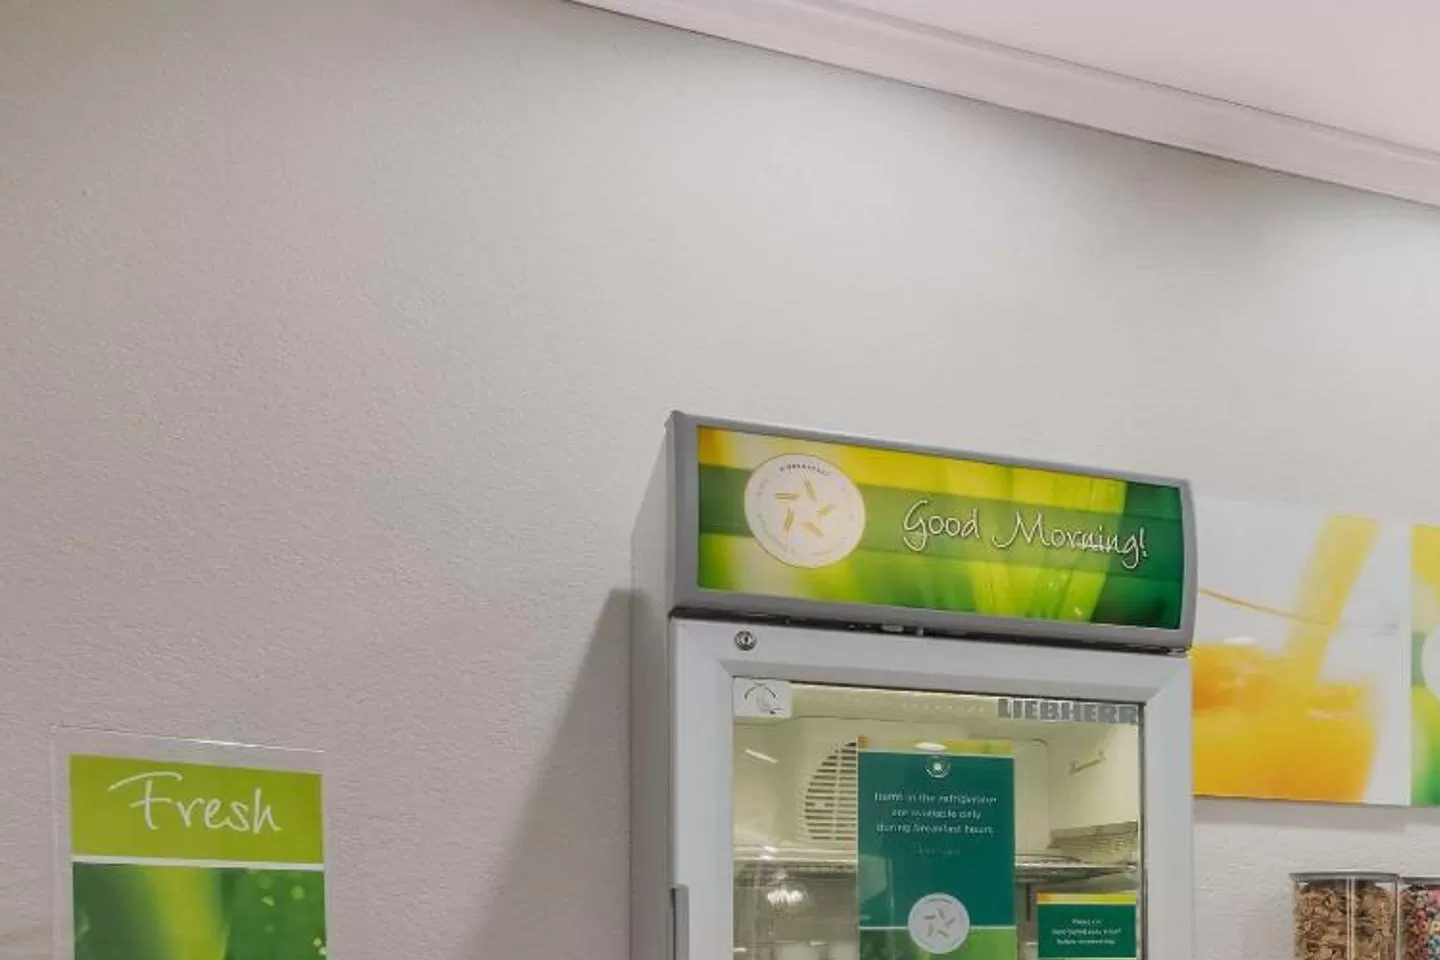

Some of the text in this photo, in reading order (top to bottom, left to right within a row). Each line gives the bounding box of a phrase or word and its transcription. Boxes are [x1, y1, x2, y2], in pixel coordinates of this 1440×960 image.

[902, 499, 1148, 570] Good Morning!
[998, 698, 1139, 724] LIEBHERR
[106, 770, 283, 834] Fresh
